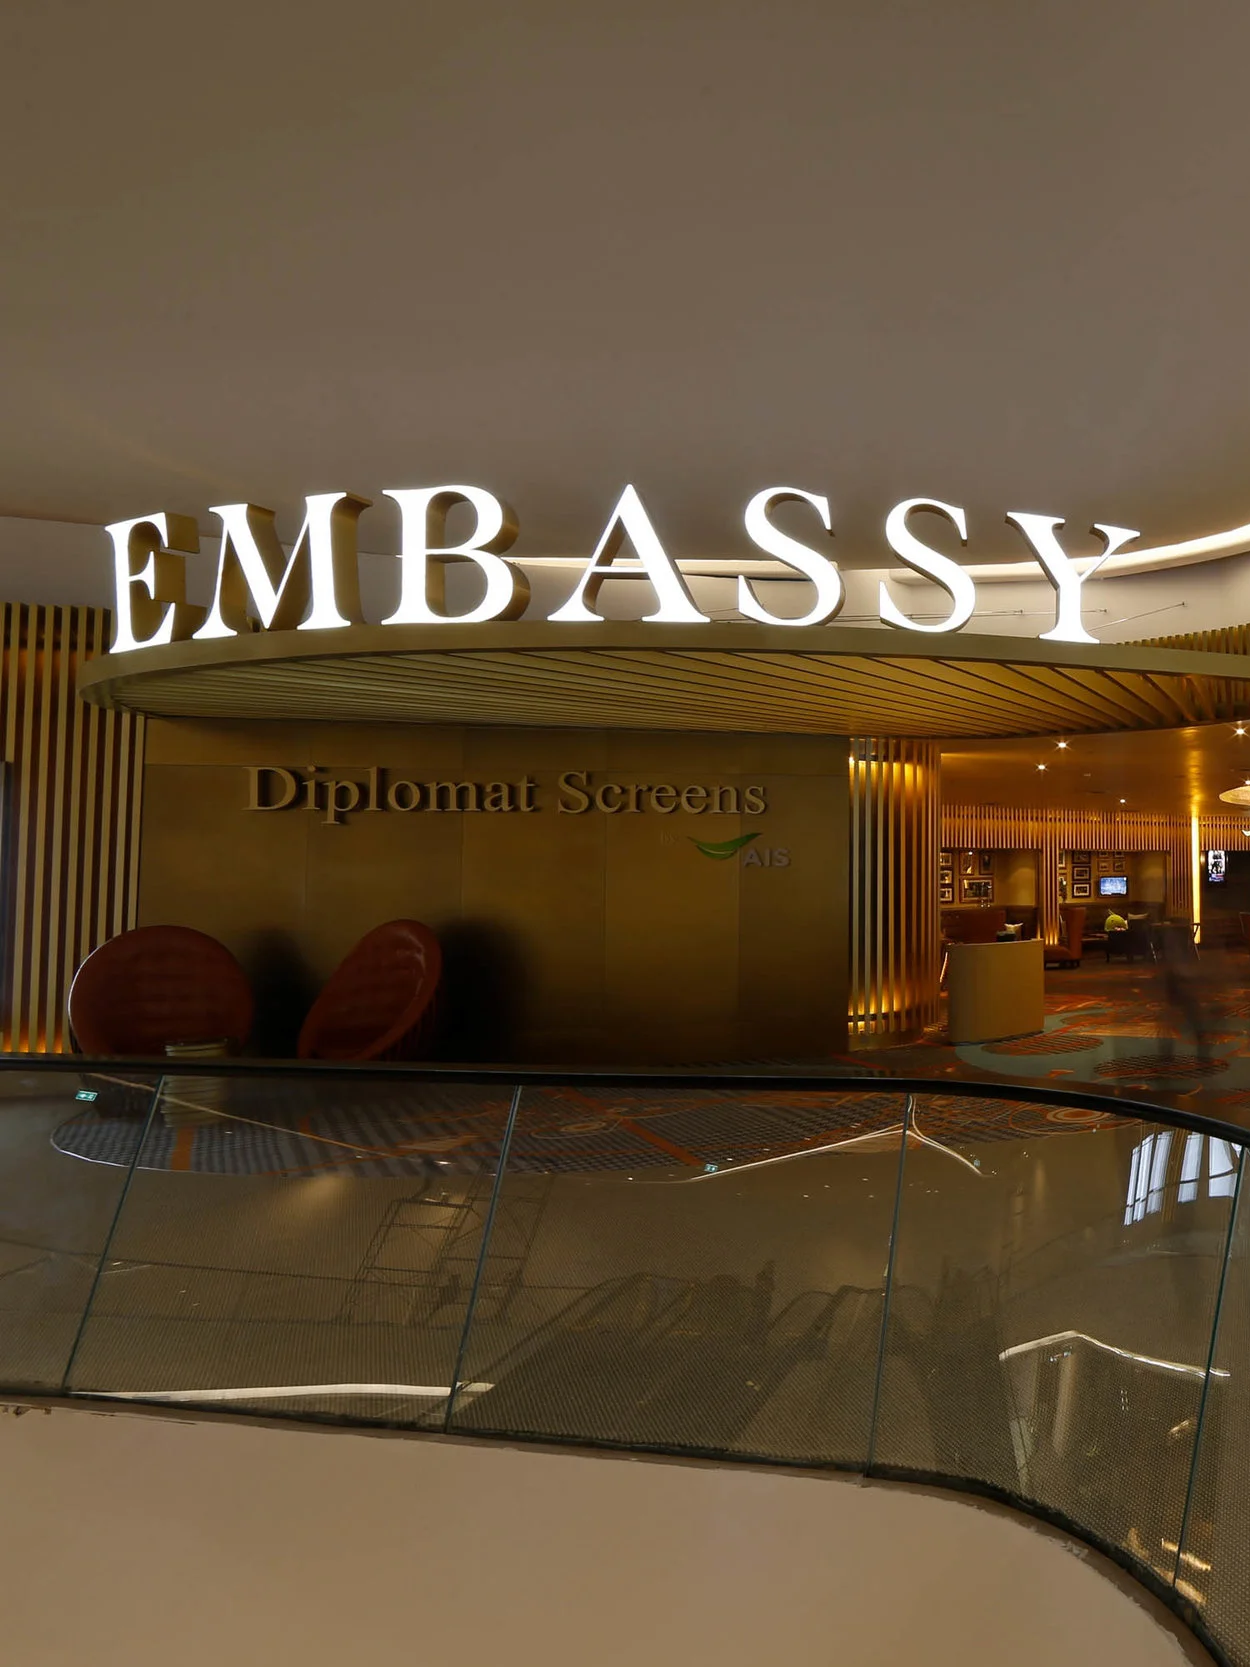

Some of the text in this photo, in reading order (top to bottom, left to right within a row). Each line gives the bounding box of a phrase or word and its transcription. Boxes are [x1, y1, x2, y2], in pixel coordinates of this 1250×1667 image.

[104, 483, 1141, 655] EMBASSY
[243, 763, 768, 825] Diplomat Screens
[743, 847, 792, 868] AIS
